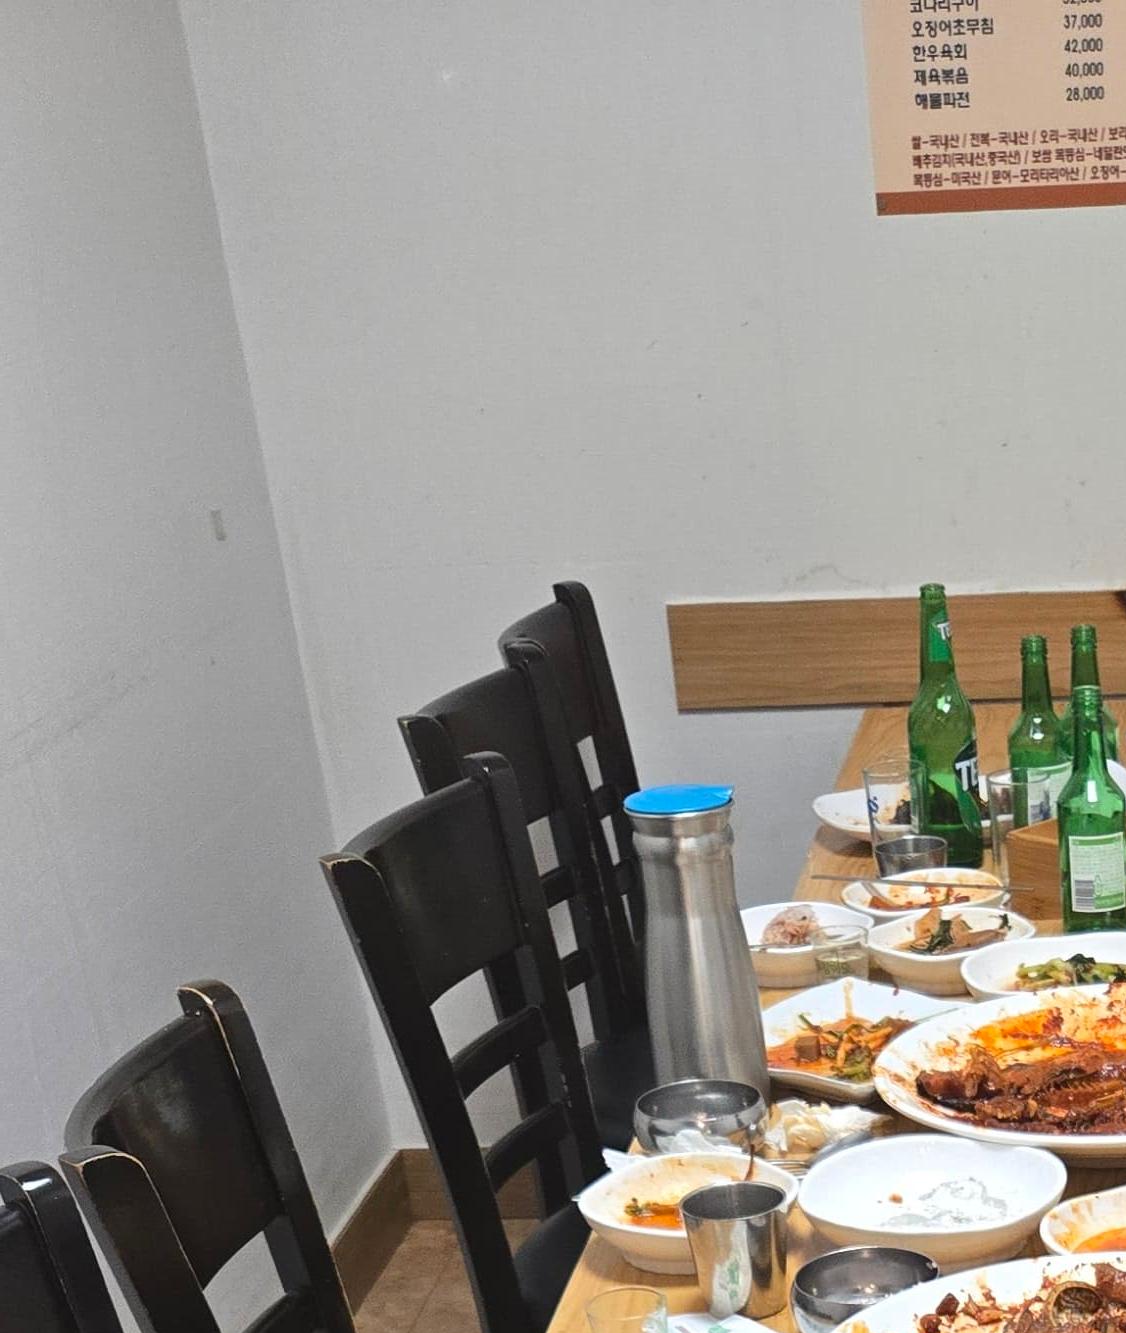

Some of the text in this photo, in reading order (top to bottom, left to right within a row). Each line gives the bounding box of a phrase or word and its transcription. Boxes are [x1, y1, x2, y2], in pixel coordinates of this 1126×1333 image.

[911, 14, 1103, 38] 오징어초무침 37,000
[912, 38, 1103, 62] 한우육회 42,000
[914, 62, 1104, 86] 제육볶음 40,000
[915, 86, 1105, 110] 해물파전 28,000
